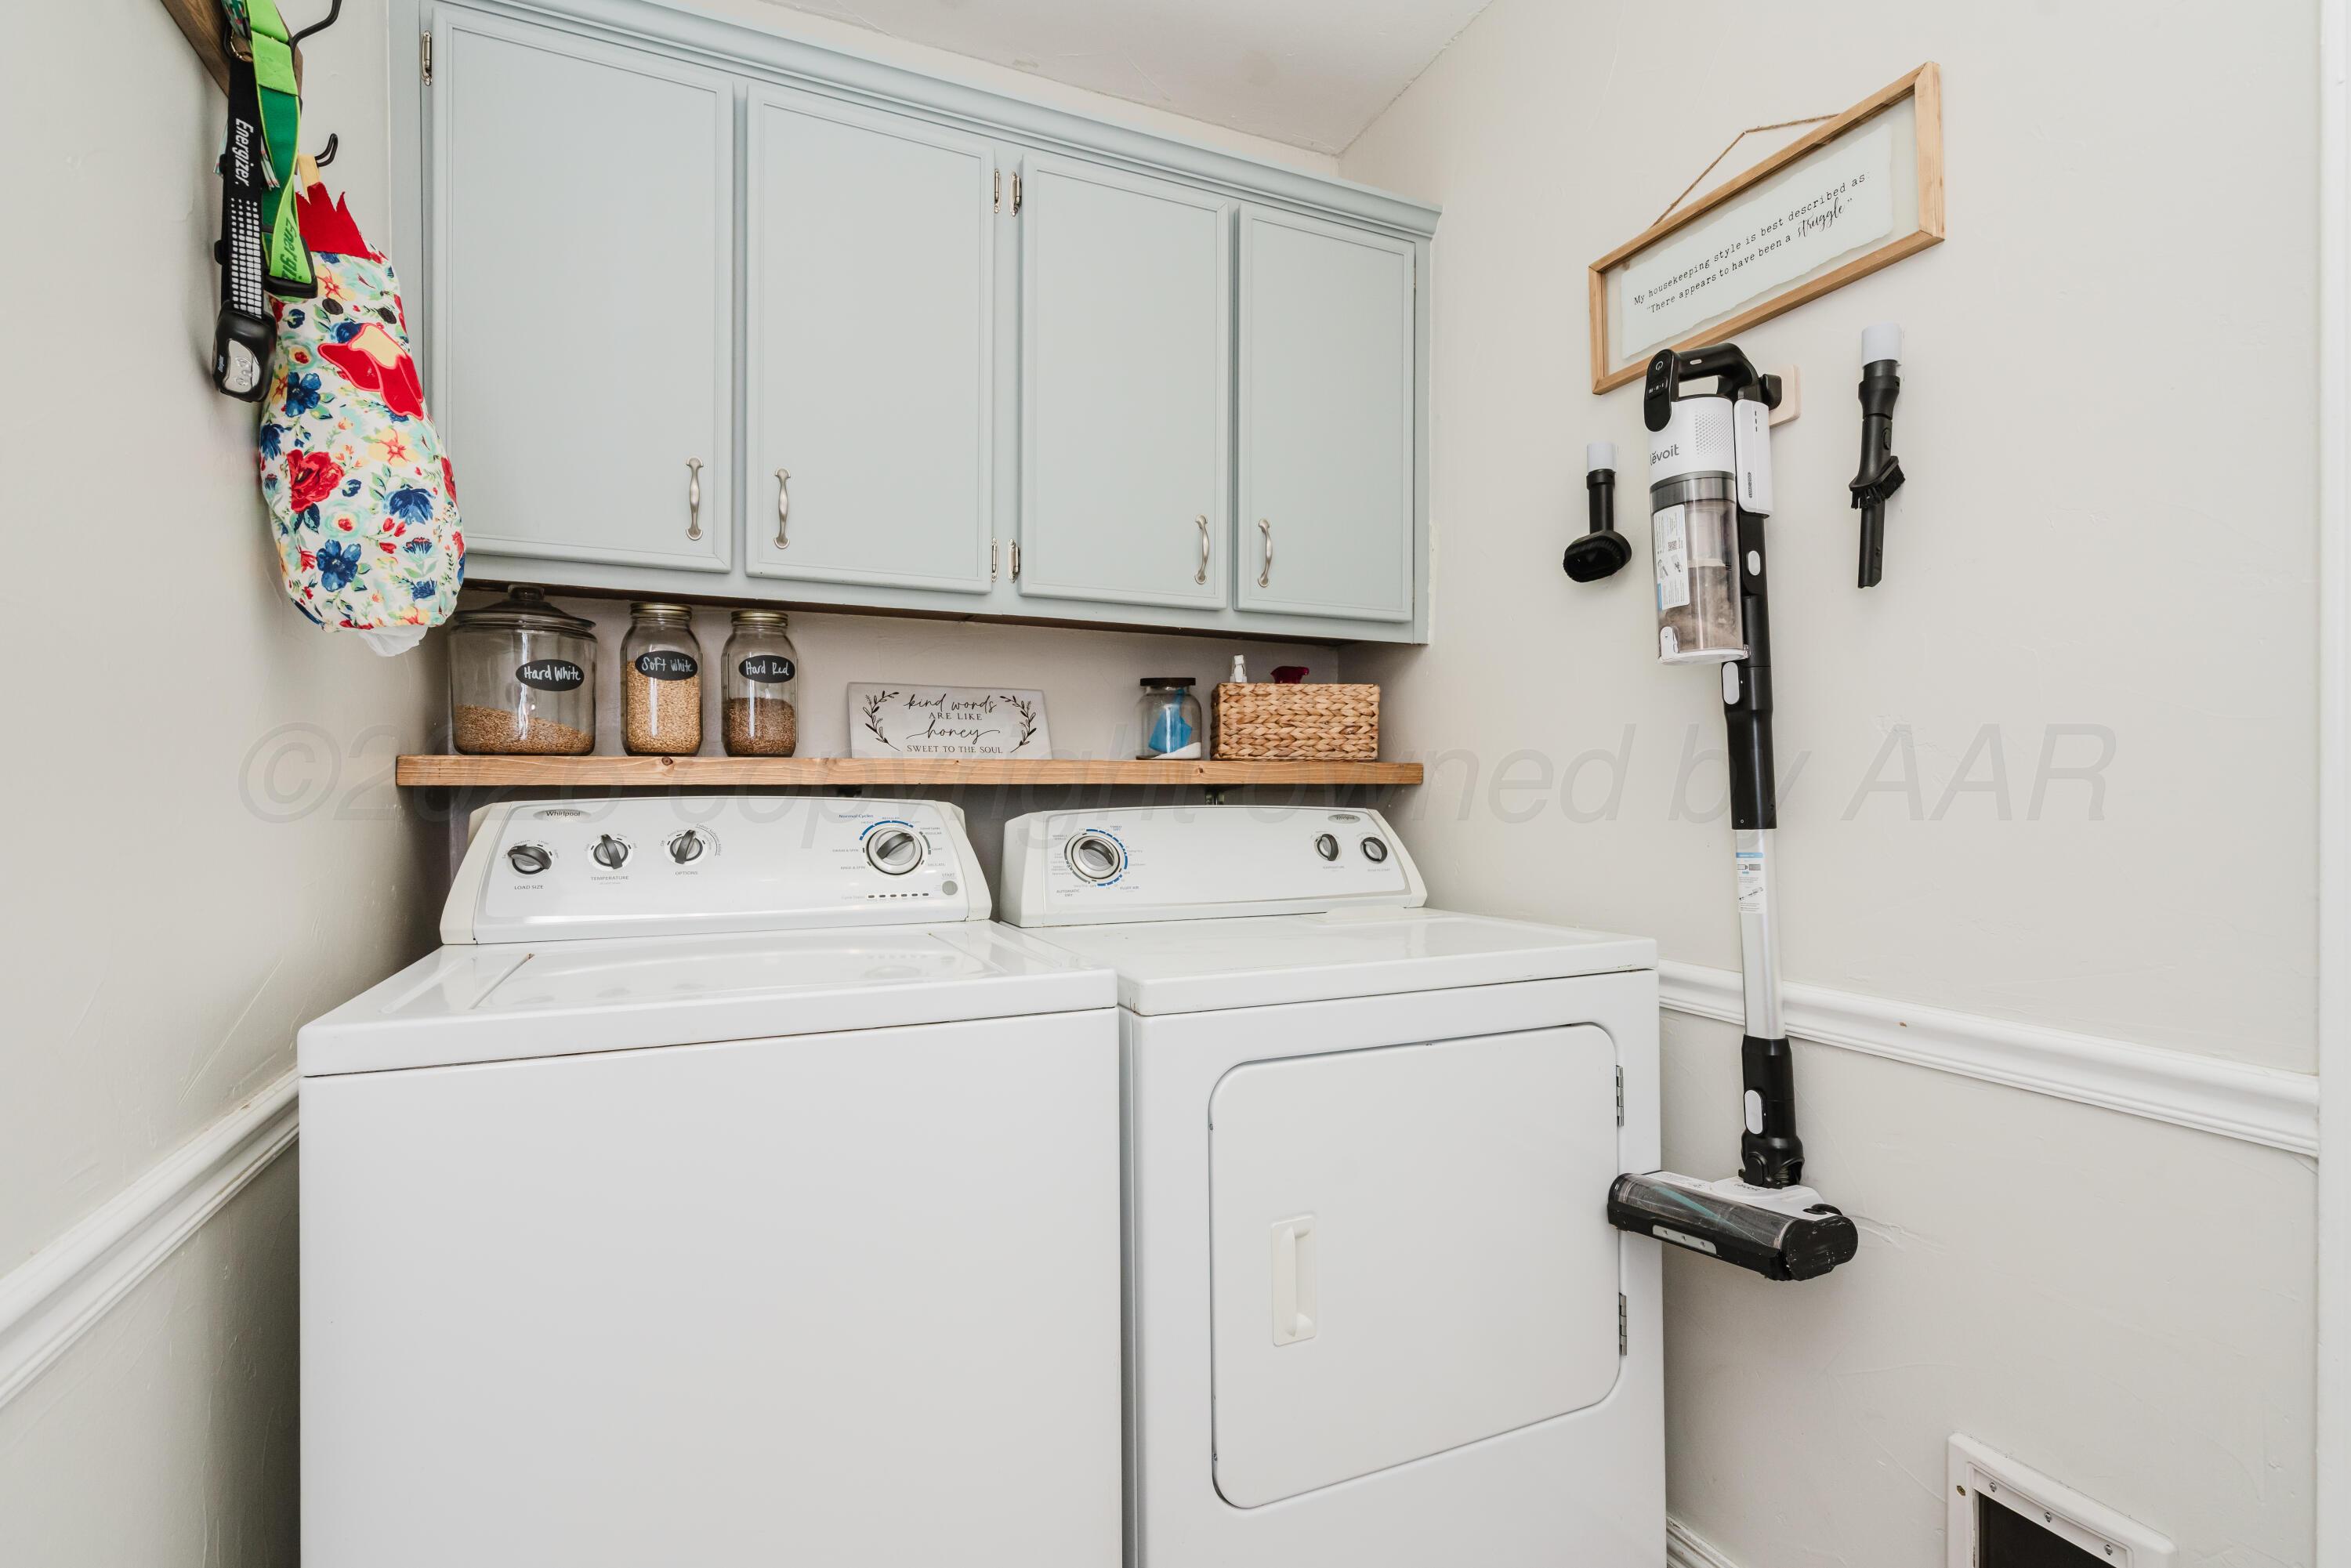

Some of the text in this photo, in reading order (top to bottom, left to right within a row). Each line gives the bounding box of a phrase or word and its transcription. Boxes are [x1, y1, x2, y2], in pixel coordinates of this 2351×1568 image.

[1634, 294, 1645, 305] My
[1648, 259, 1710, 298] housekeeping
[1714, 242, 1741, 262] style
[1745, 234, 1756, 245] is
[1761, 218, 1784, 237] best
[1788, 183, 1846, 221] described
[1679, 273, 1716, 298] appears
[1719, 267, 1730, 277] to
[1732, 254, 1755, 271] have
[1759, 239, 1782, 257] been
[523, 664, 581, 682] Hard White
[670, 658, 694, 672] White
[745, 660, 789, 675] Hard Red
[903, 693, 998, 714] kind words
[929, 712, 983, 721] ARE LIKE
[906, 719, 1001, 744] honey
[907, 744, 939, 753] SWEET
[958, 745, 976, 754] THE
